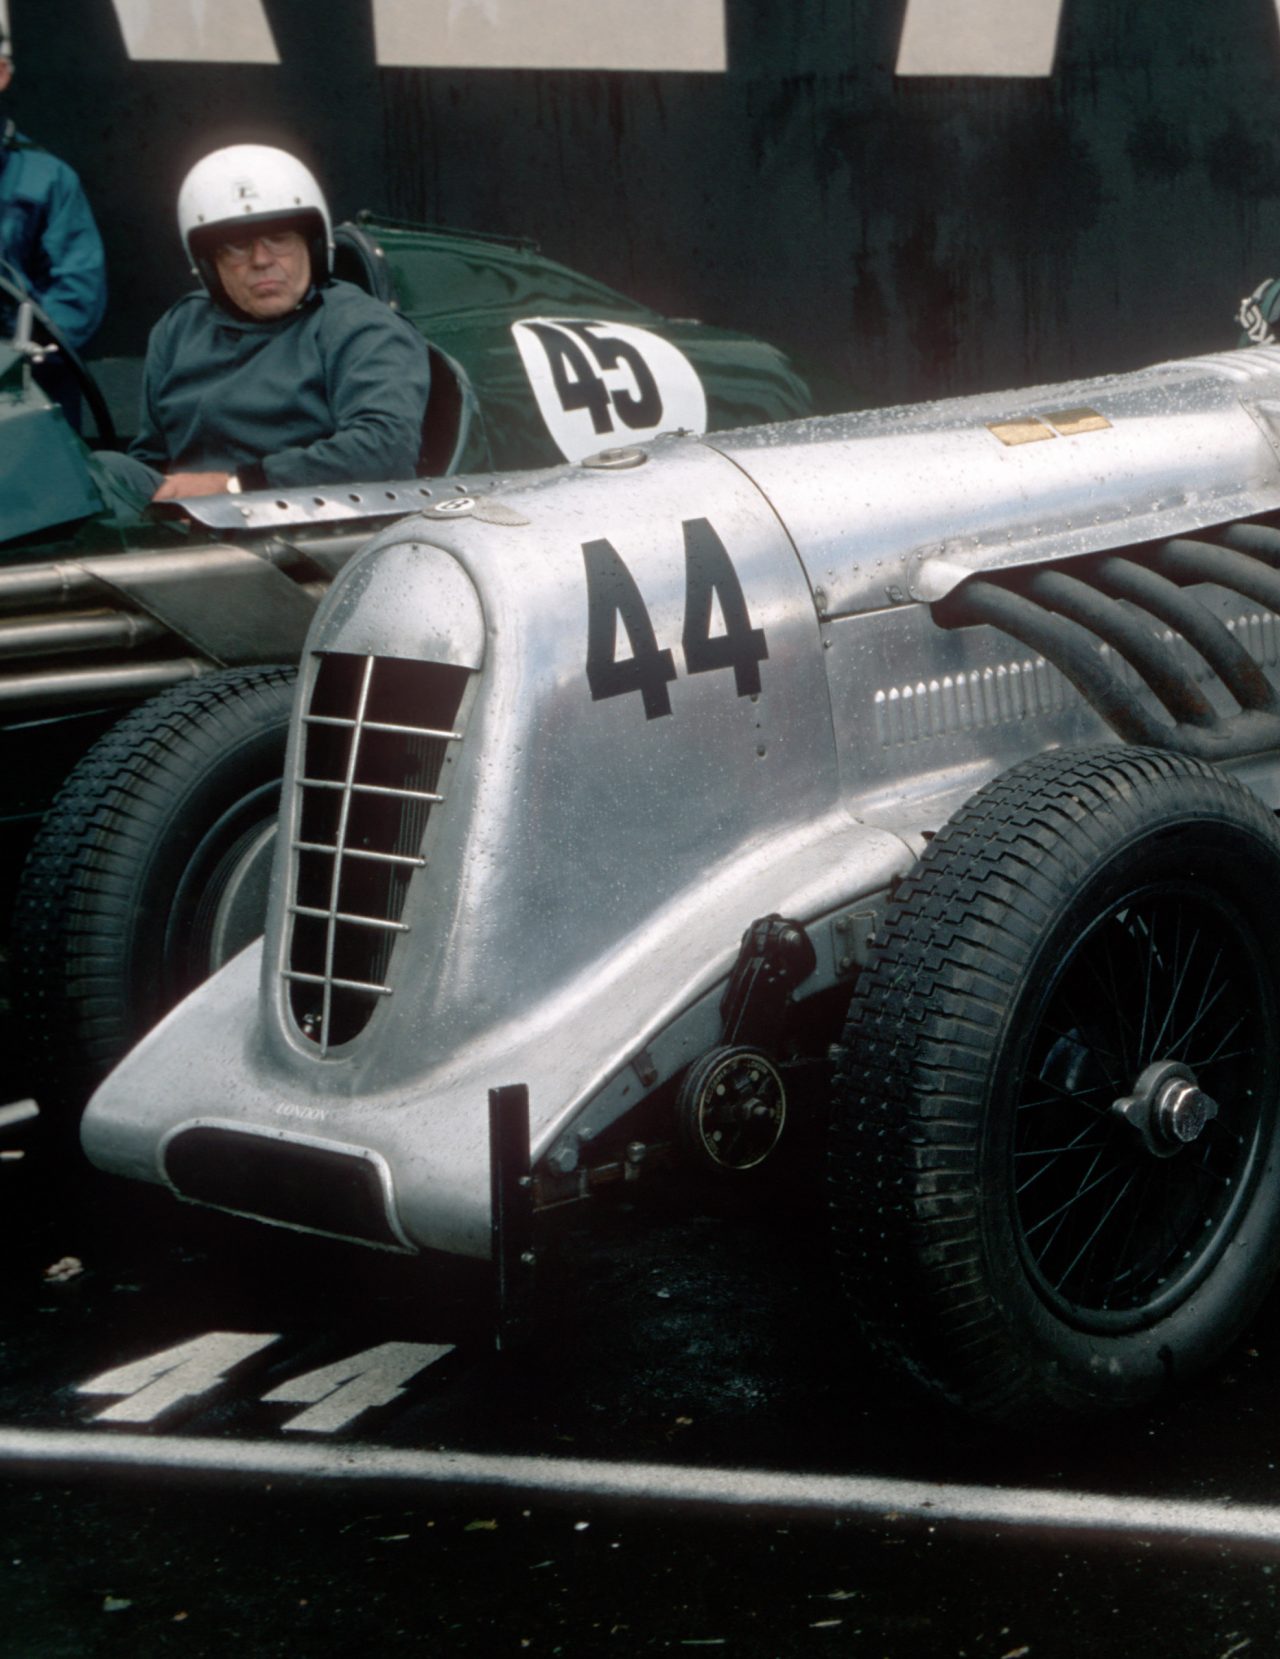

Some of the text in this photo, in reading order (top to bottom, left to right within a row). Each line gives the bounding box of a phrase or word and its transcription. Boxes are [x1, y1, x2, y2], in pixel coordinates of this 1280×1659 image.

[519, 321, 663, 434] 45
[580, 516, 769, 722] 44
[276, 1102, 330, 1121] LONDON
[75, 1331, 457, 1433] 44
